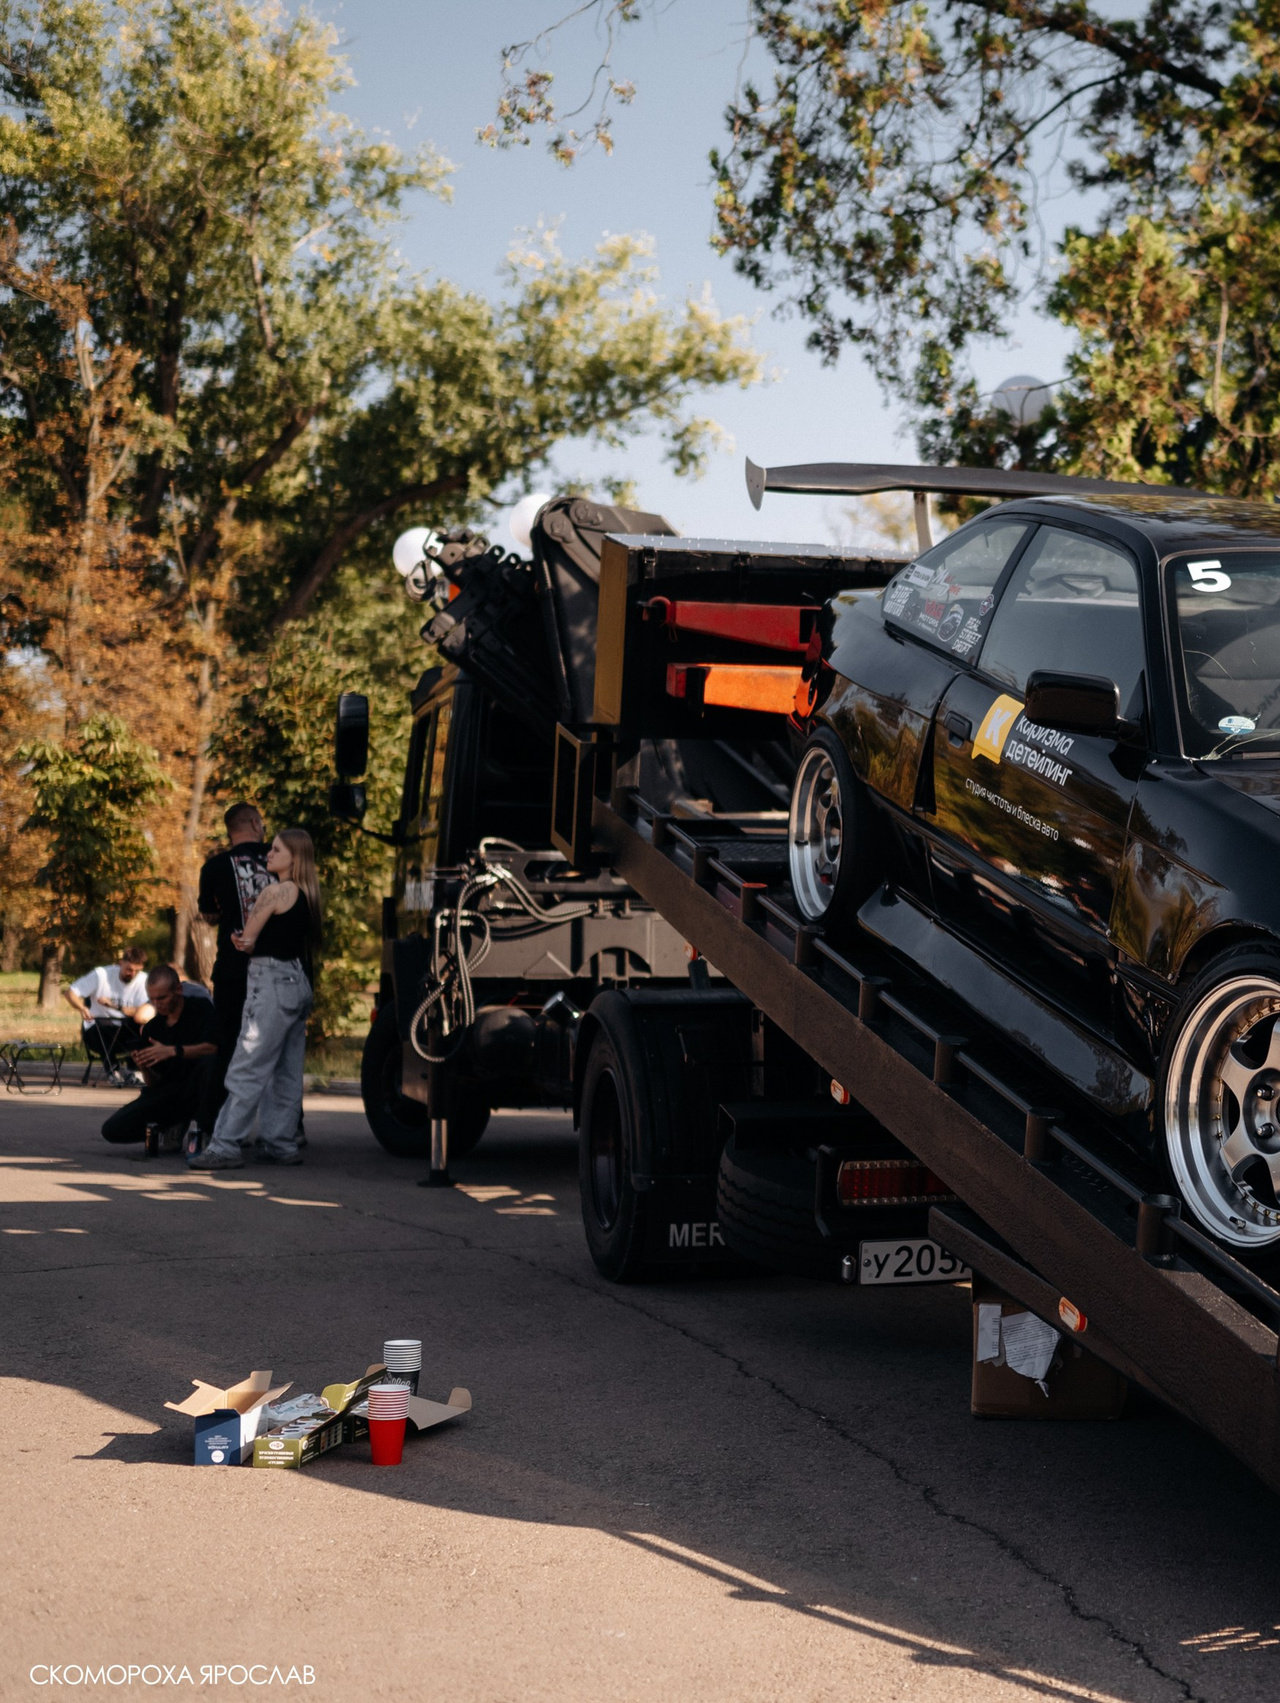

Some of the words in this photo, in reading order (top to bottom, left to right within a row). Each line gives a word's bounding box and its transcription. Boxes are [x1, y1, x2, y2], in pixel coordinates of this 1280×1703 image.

[1187, 560, 1232, 593] 5
[919, 612, 939, 628] MOTORS
[1005, 740, 1073, 787] детейлинг
[965, 778, 987, 798] студия
[986, 790, 1012, 814] чистоты
[1017, 805, 1041, 831] блеска
[1041, 822, 1059, 841] авто
